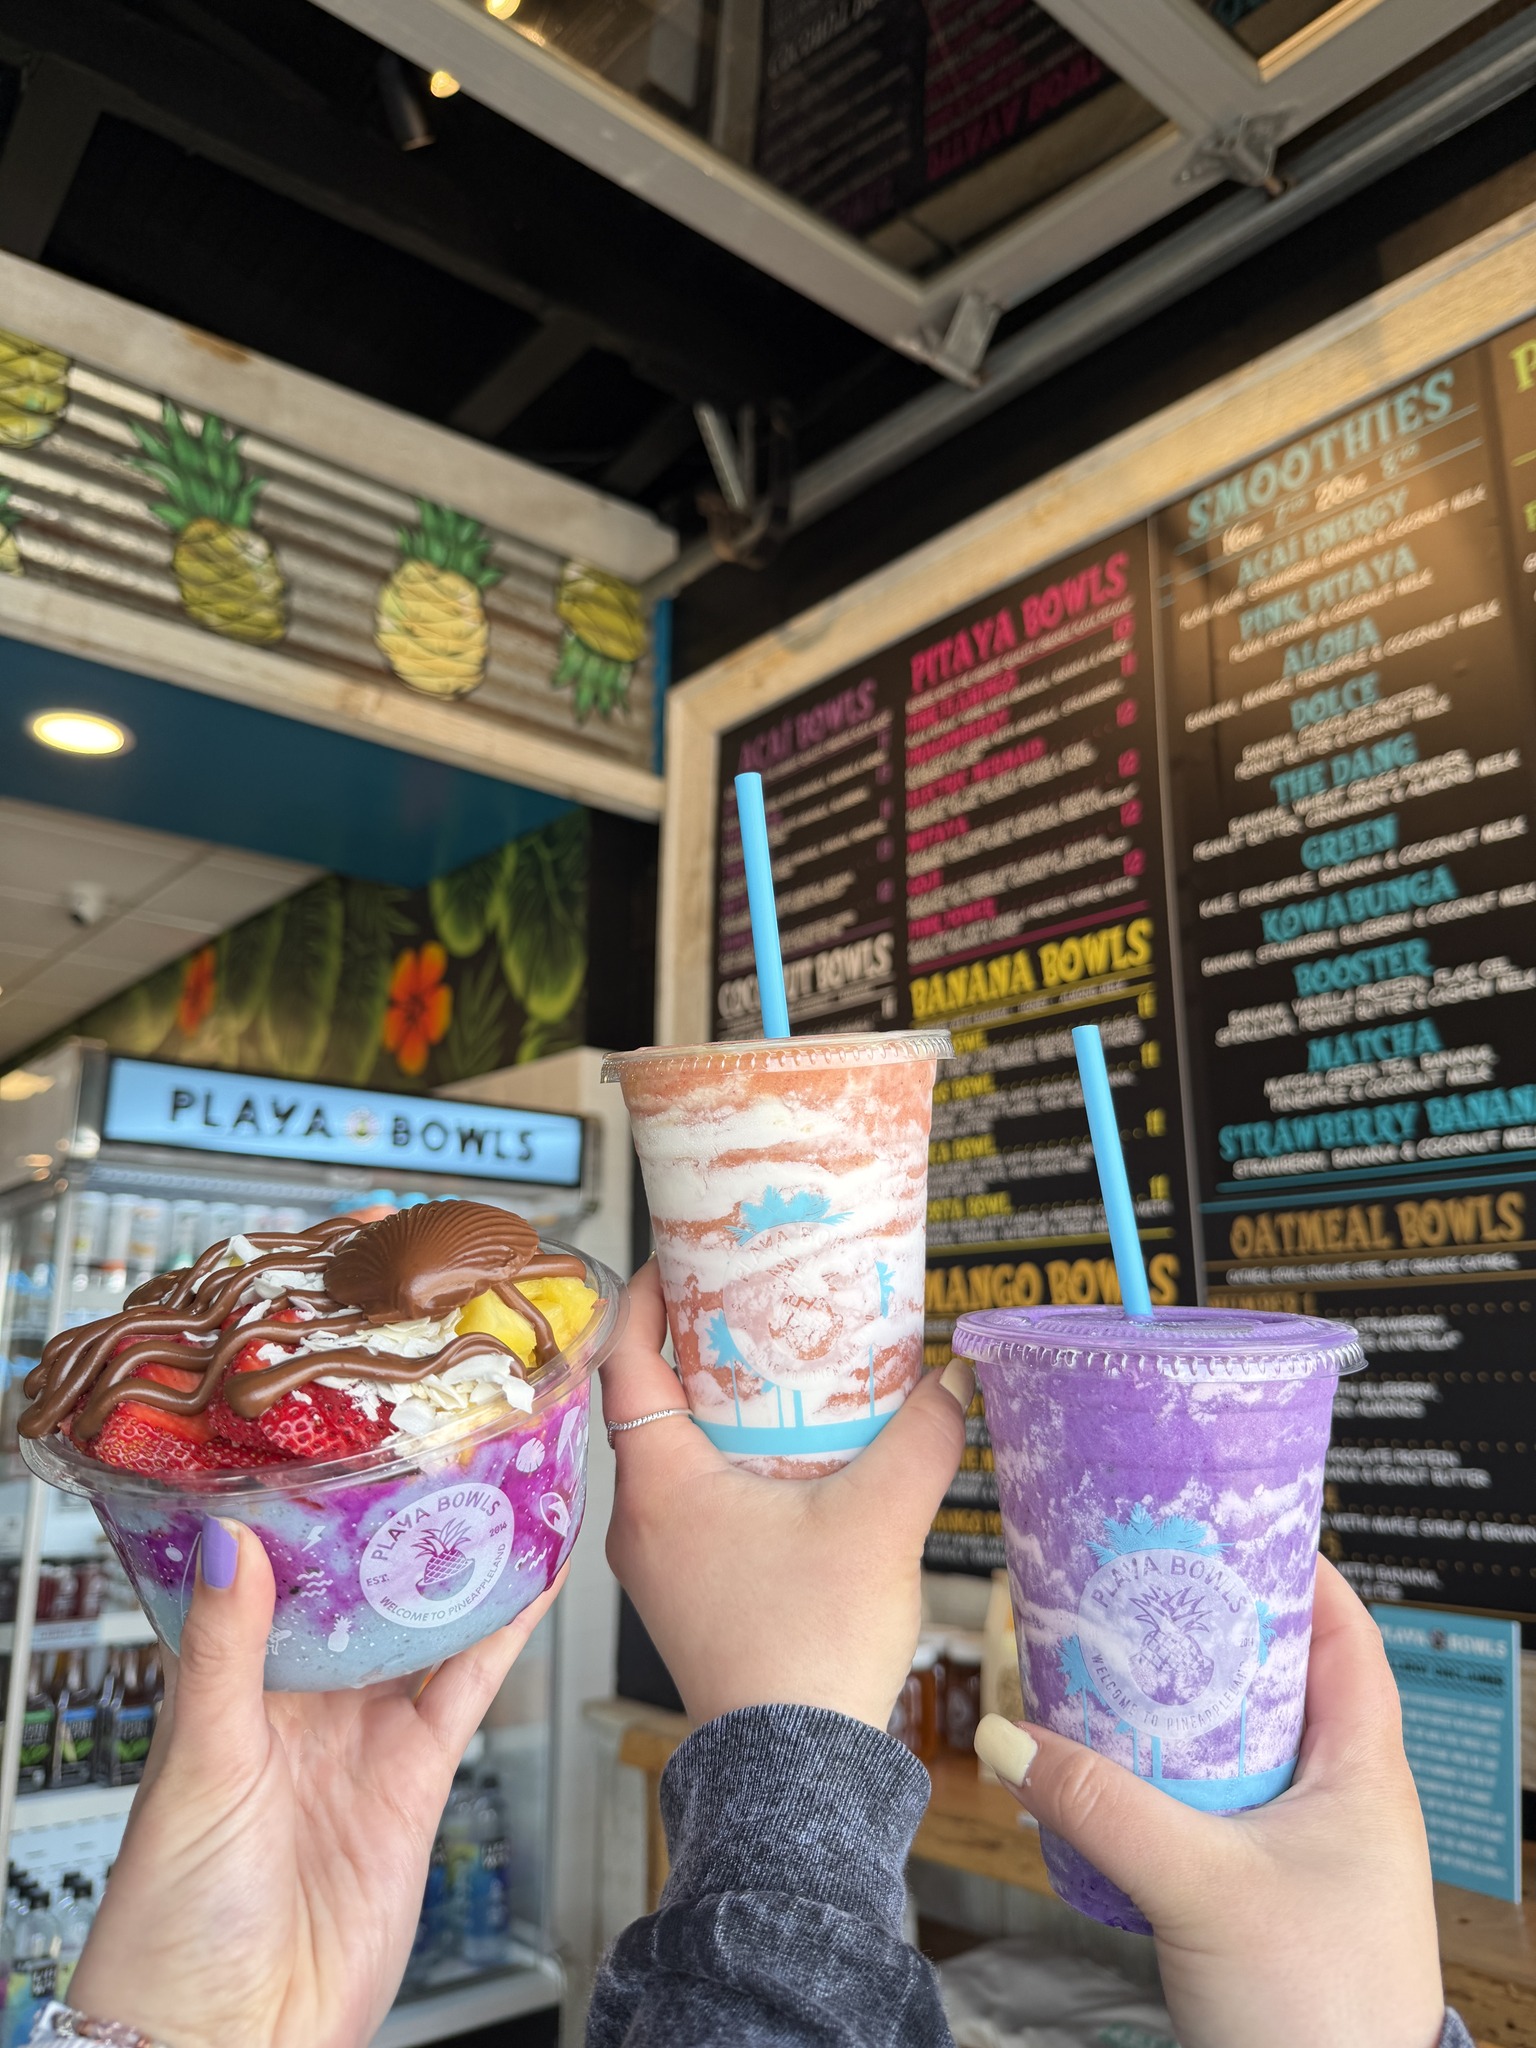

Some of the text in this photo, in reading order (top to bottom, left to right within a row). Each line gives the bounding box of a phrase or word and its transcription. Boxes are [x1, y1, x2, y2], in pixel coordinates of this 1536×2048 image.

[1187, 368, 1454, 541] SMOOTHIES
[909, 608, 1018, 692] PITAYA
[1021, 552, 1130, 639] BOWLS
[1239, 592, 1305, 639] PINK
[1308, 542, 1418, 613] PITAYA
[1283, 615, 1381, 677] ALOHA
[795, 677, 877, 746] BOWLS
[1290, 670, 1381, 732] DOLCE
[1270, 731, 1418, 806] THE DANG
[1300, 812, 1399, 872] GREEN
[1261, 863, 1459, 944] KOWABUNGA
[717, 931, 895, 1020] COCUT BOWLS
[910, 948, 1035, 1020] BANANA
[1038, 917, 1153, 989] BOWLS
[1292, 937, 1436, 998] BOOSTER
[1305, 1016, 1445, 1073] MATCHA
[171, 1089, 533, 1162] PLAYA BOWLS
[1218, 1100, 1421, 1162] STRAWBERRY
[1229, 1204, 1395, 1260] OATMEAL
[1395, 1191, 1526, 1248] BOWLS
[925, 1253, 1180, 1313] MANGO BOWS
[371, 1490, 501, 1561] PLAYA BOWLS
[489, 1521, 508, 1538] 2014
[366, 1573, 390, 1587] EST.
[380, 1543, 506, 1622] WELCOME TO PINEAPPLELAND
[1091, 1555, 1247, 1614] PLAYA BOWLS
[1091, 1654, 1138, 1716] WELCOME
[1143, 1710, 1159, 1726] TO
